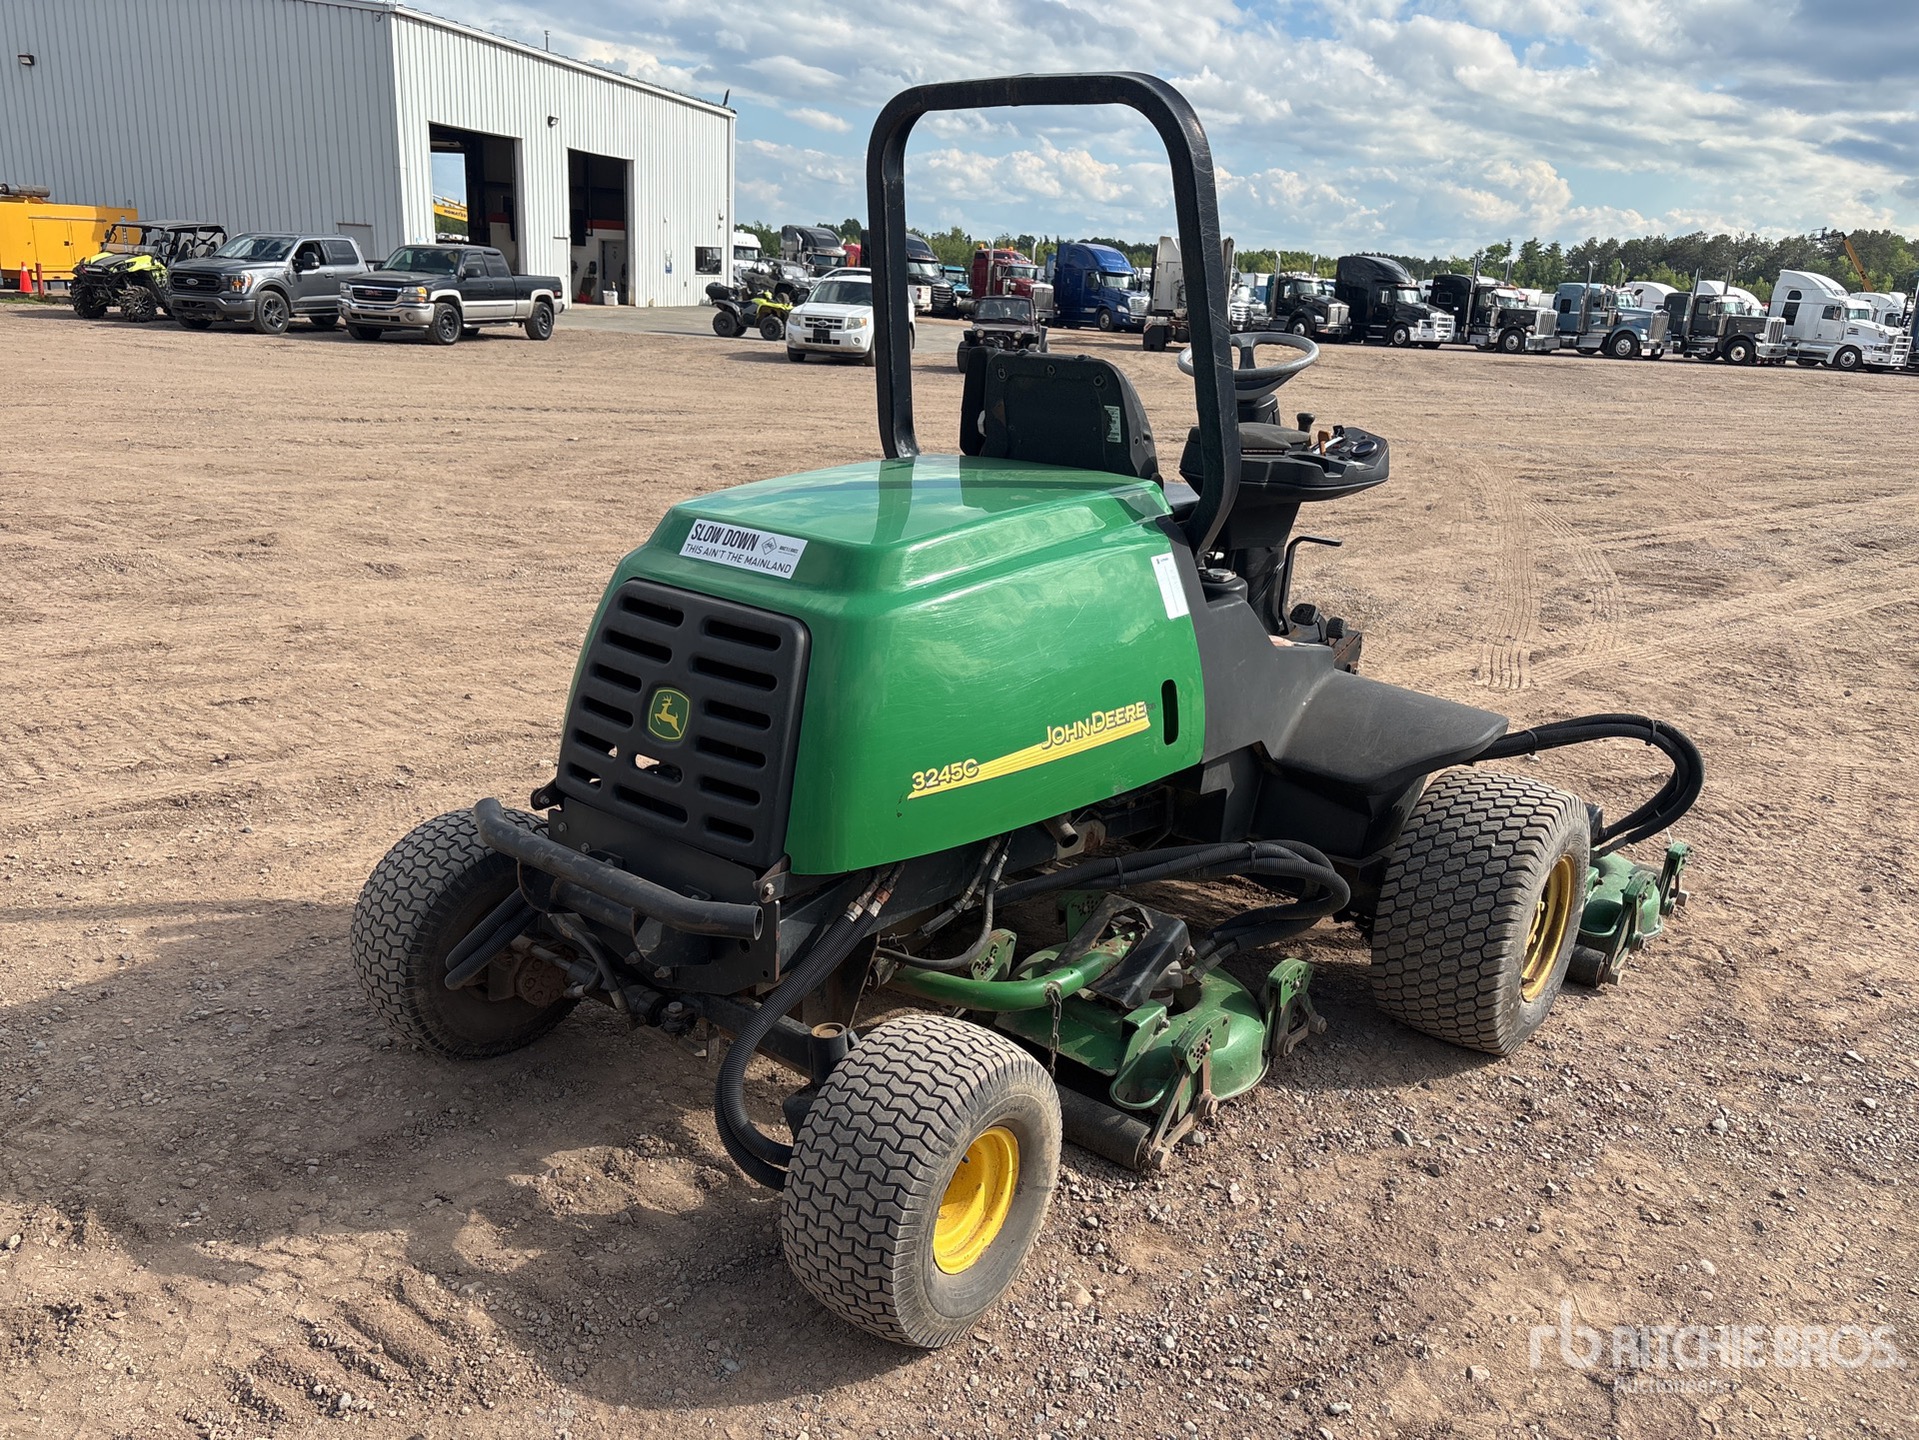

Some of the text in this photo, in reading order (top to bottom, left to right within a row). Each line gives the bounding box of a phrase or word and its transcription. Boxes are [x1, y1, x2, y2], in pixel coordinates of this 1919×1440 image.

[691, 523, 725, 544] SLOW
[722, 529, 760, 552] DOWN
[685, 543, 792, 574] THIS AIN'T THE MAINLAND
[911, 758, 980, 791] 3245C
